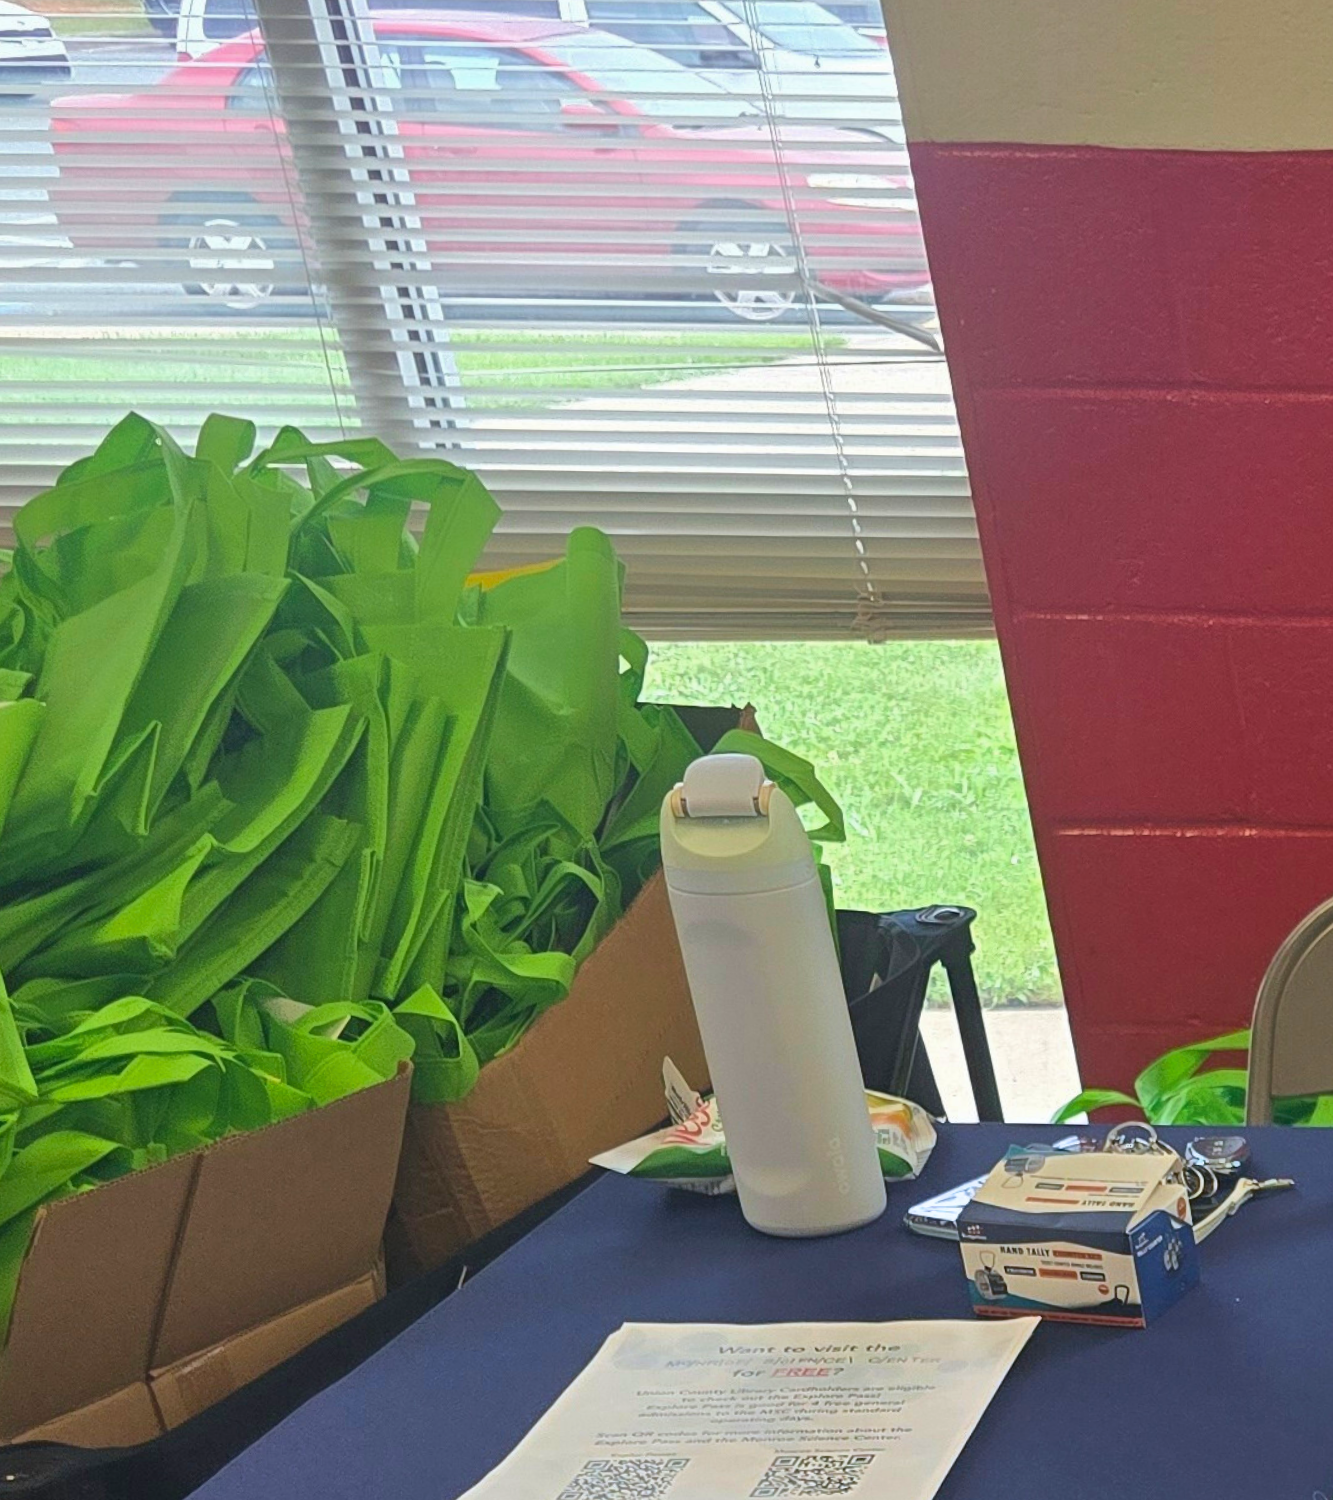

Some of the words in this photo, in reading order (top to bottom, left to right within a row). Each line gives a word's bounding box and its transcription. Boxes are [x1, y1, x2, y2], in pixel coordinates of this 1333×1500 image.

[1000, 1246, 1024, 1255] HAND
[1026, 1247, 1050, 1257] TALLY
[718, 1345, 775, 1355] Want
[784, 1345, 805, 1354] to
[814, 1344, 859, 1353] visit
[865, 1343, 902, 1353] the
[733, 1369, 766, 1378] for
[770, 1367, 845, 1378] FREE?
